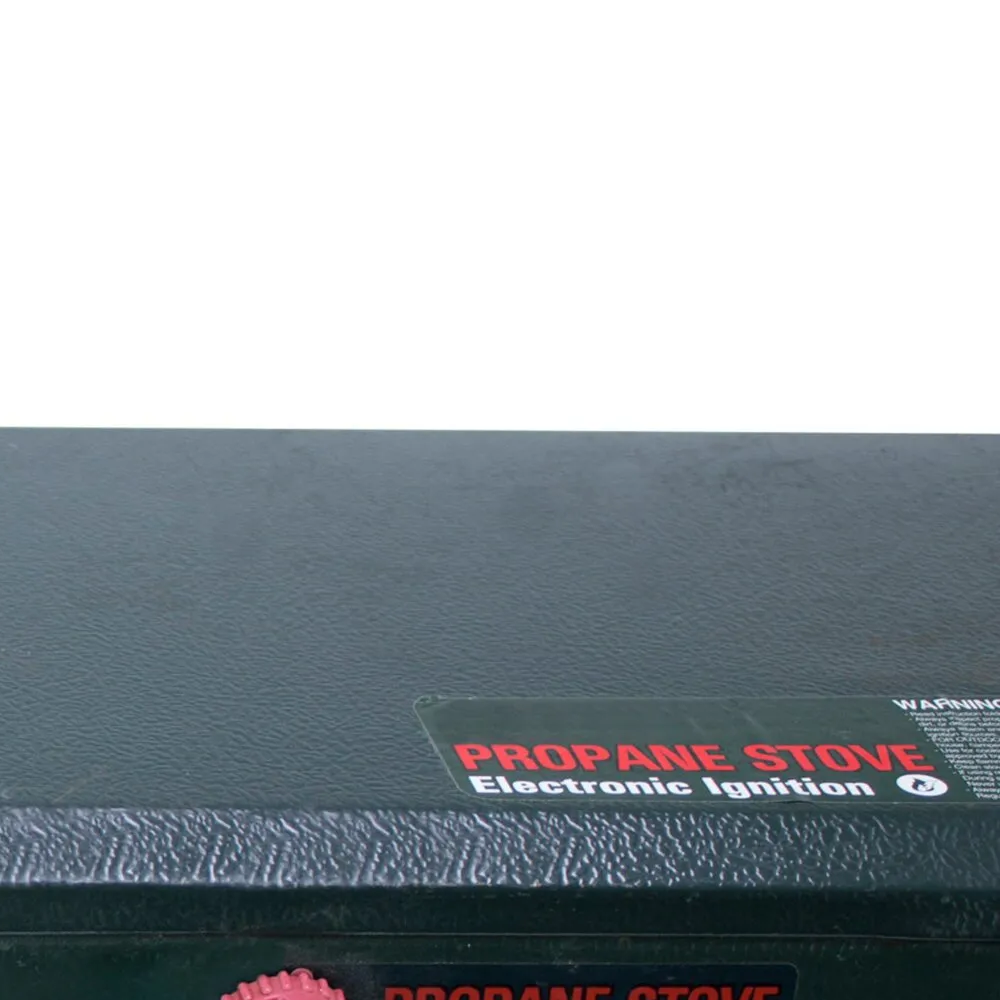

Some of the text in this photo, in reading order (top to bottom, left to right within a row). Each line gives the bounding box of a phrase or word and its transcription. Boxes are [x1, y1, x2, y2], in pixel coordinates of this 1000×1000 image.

[453, 743, 936, 773] PROPANE STOVE
[467, 775, 876, 799] Electronic Ignition
